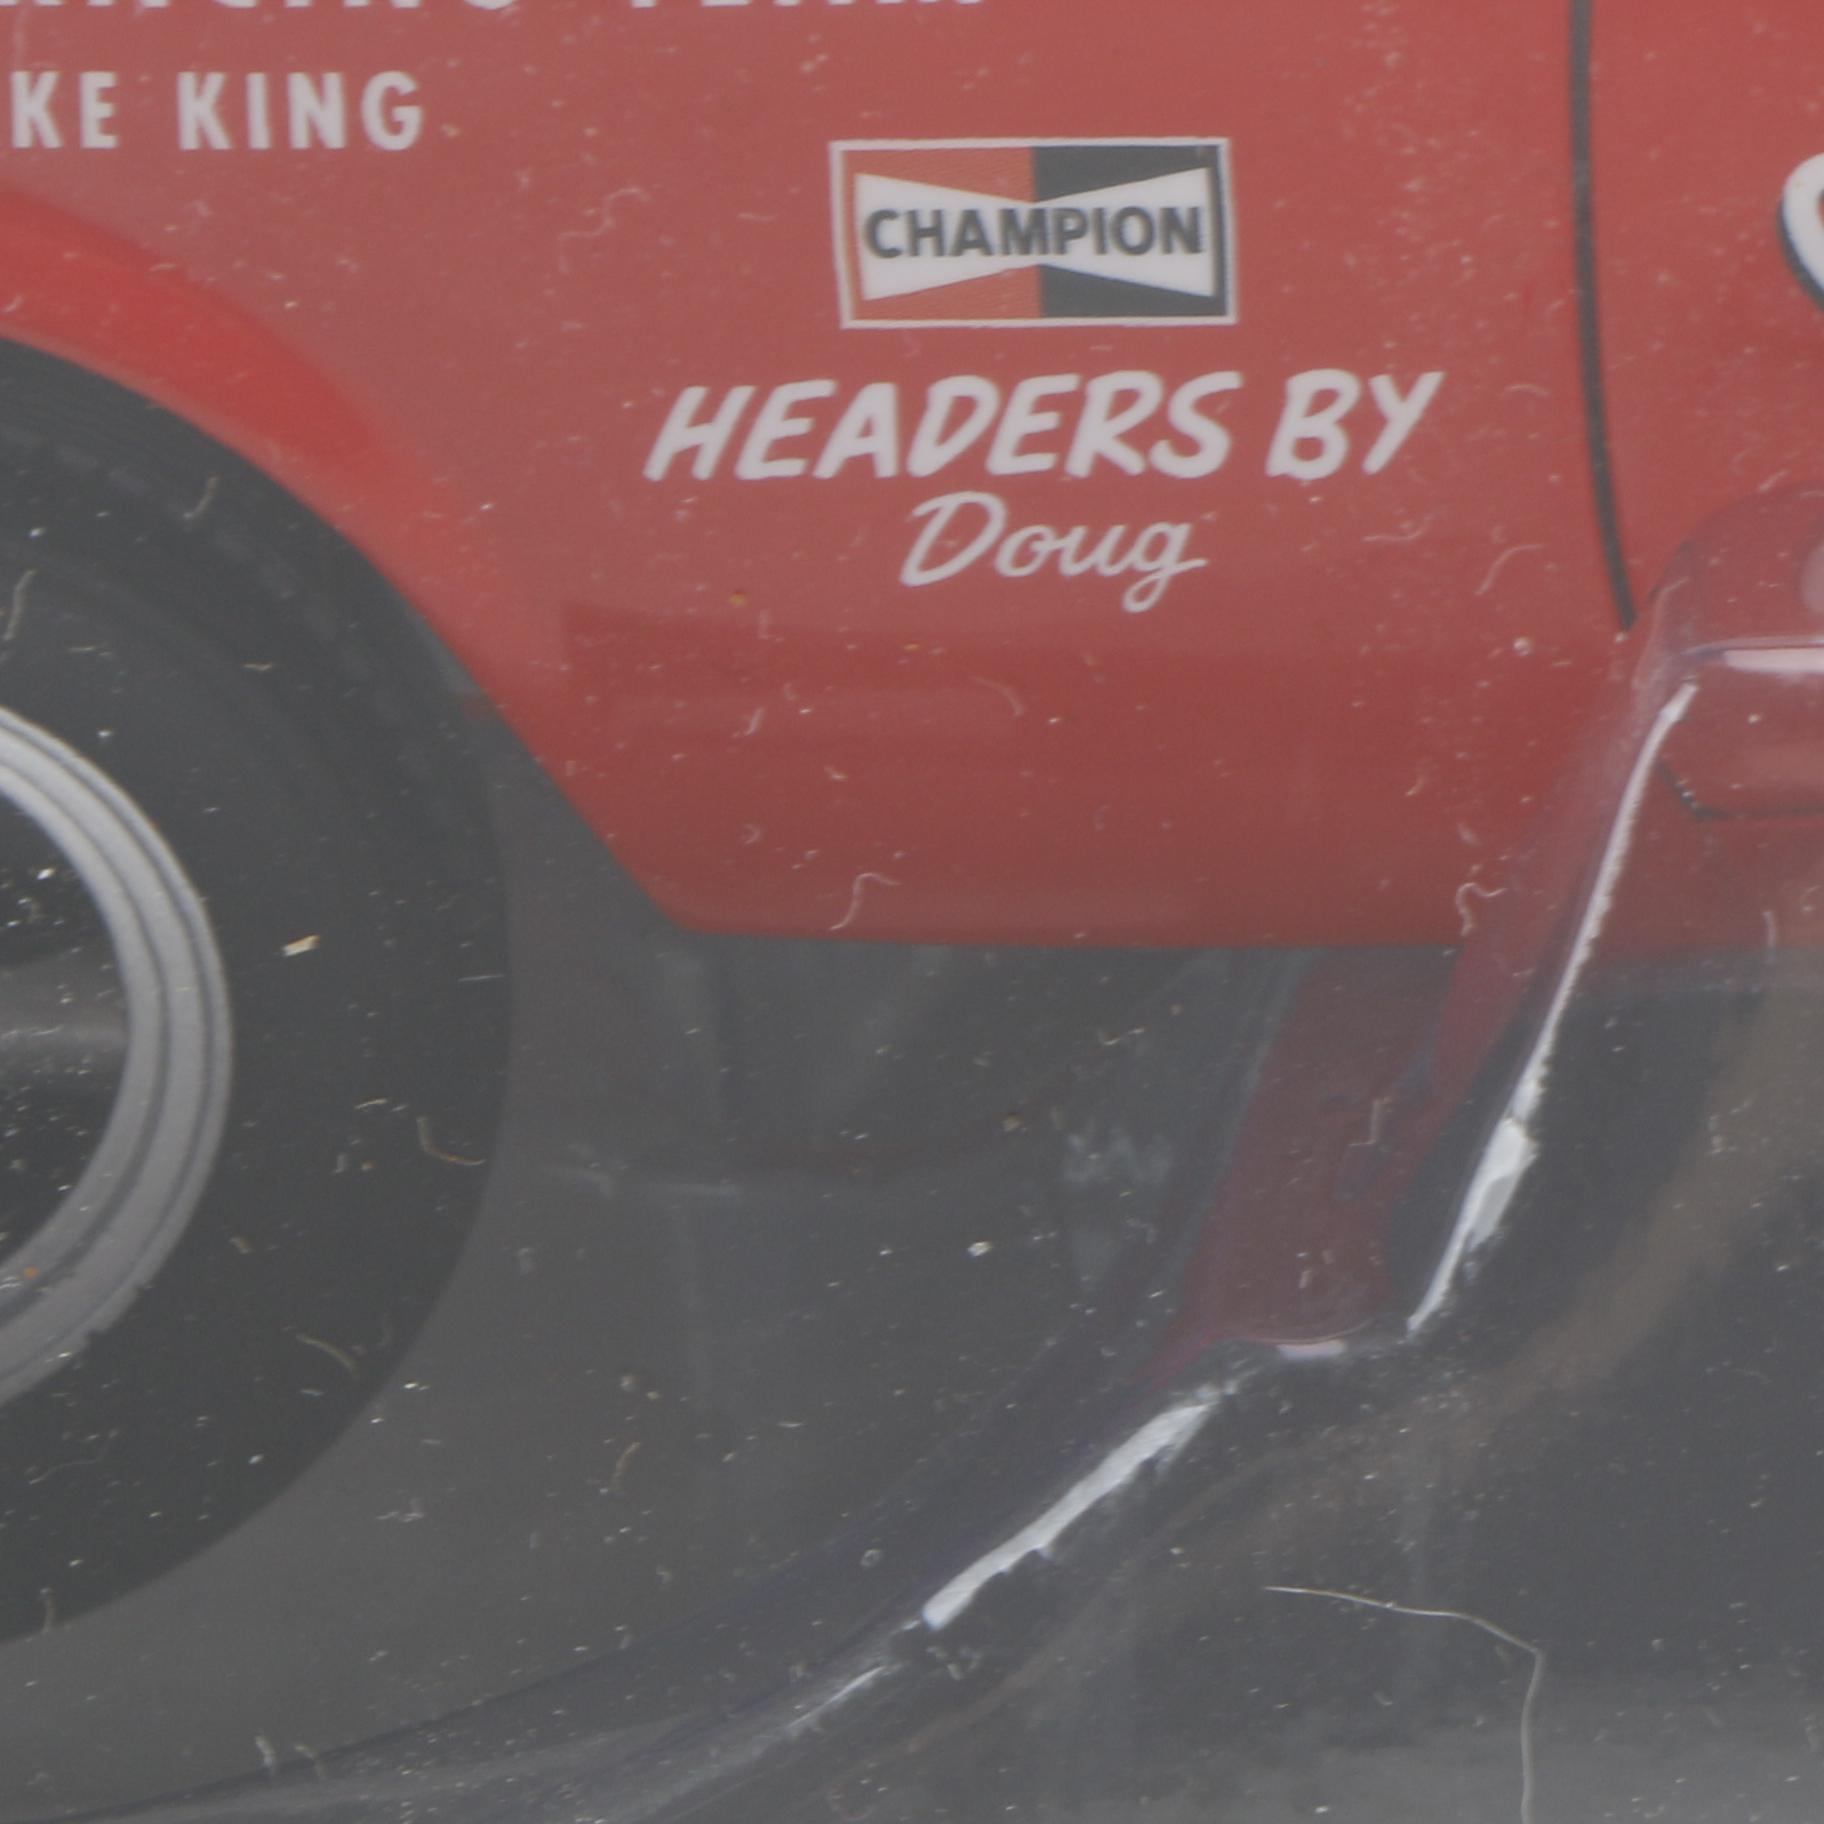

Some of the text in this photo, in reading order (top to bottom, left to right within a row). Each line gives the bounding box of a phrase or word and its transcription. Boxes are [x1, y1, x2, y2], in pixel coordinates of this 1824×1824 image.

[176, 70, 424, 151] KING
[863, 205, 1207, 260] CHAMPION
[642, 368, 1445, 482] HEADERS BY
[899, 490, 1208, 613] Doug
